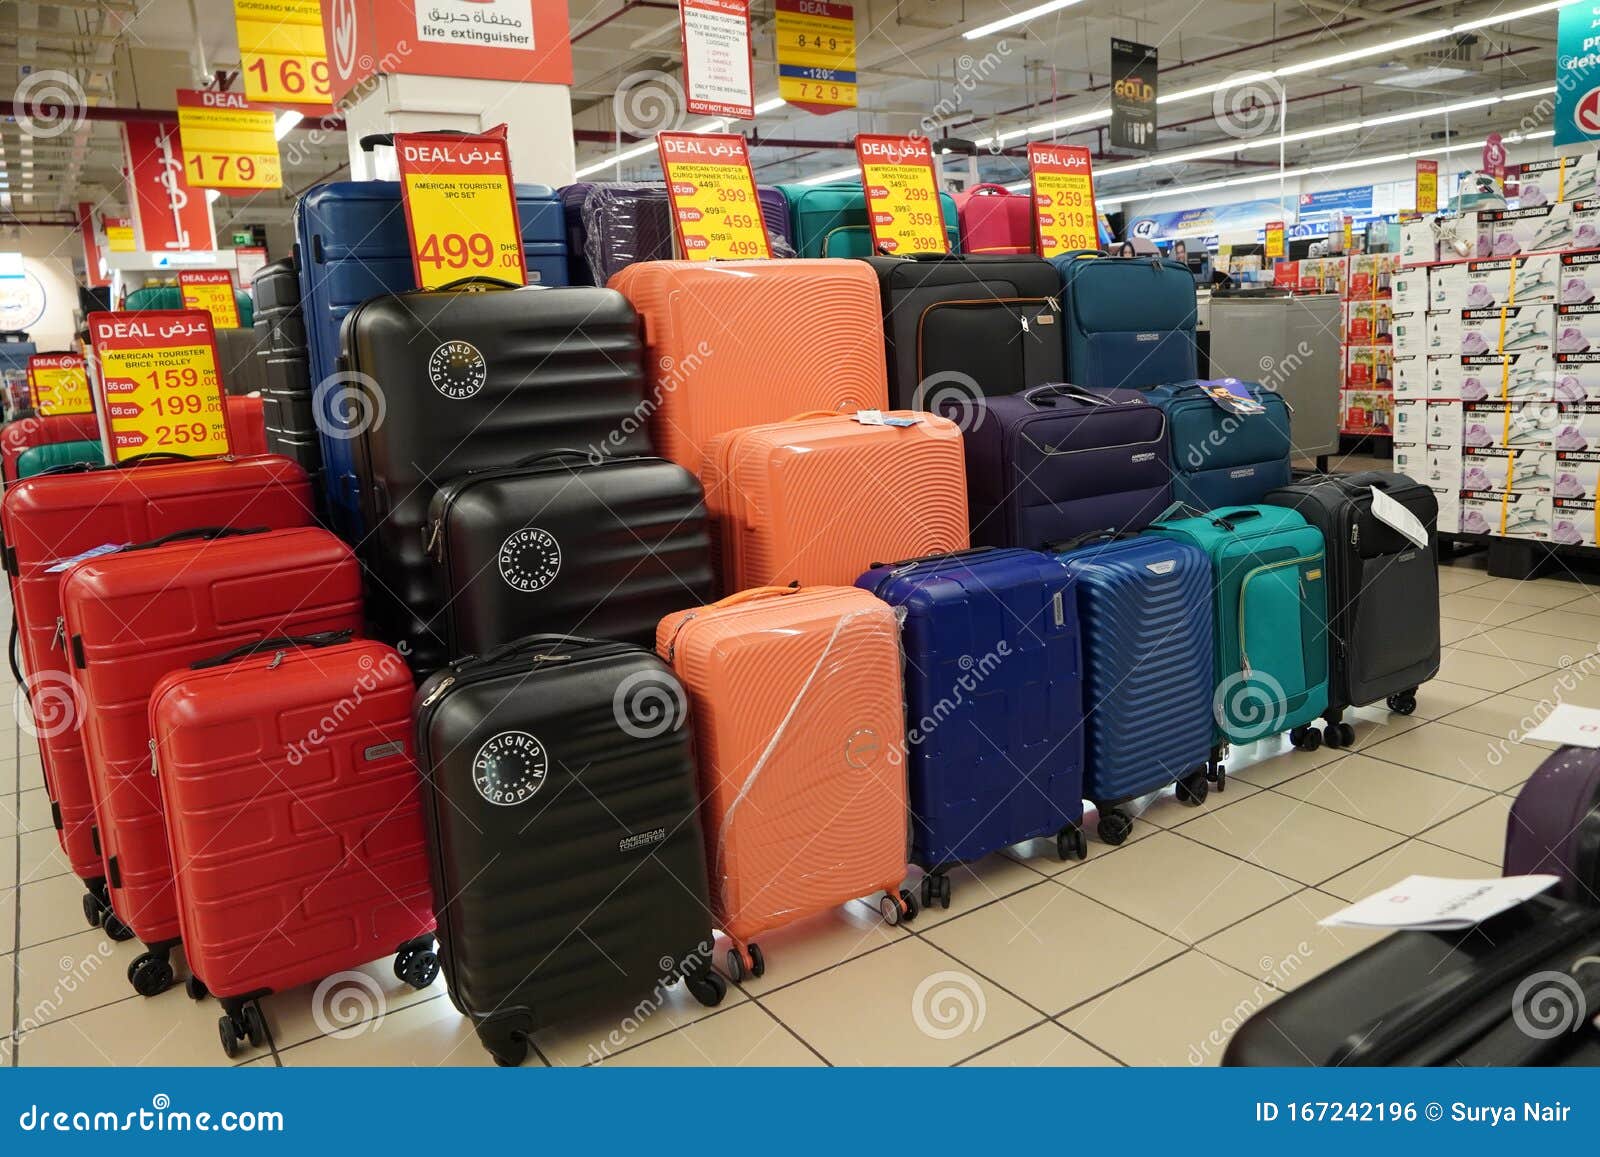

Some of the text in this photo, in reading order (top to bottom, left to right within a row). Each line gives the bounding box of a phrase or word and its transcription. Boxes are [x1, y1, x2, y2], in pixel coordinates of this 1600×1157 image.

[238, 2, 283, 12] GIORDANO
[800, 1, 830, 16] DEAL
[428, 8, 522, 28] مطفأة حريق
[720, 16, 746, 26] CUSTOMER
[422, 25, 529, 44] fire extinguisher
[704, 32, 732, 40] WARRANTY
[248, 57, 331, 95] 169
[800, 83, 838, 100] 729
[1114, 80, 1154, 104] GOLD
[203, 92, 248, 108] DEAL
[690, 102, 708, 110] BODY
[722, 106, 752, 116] INCLUDED
[404, 146, 456, 162] DEAL
[665, 140, 706, 154] DEAL
[708, 143, 744, 156] عرض
[862, 142, 897, 156] DEAL
[898, 144, 928, 158] عرض
[459, 148, 504, 164] عرض
[1033, 152, 1062, 165] DEAL
[1063, 154, 1087, 167] عرض
[189, 155, 255, 180] 179
[717, 188, 747, 202] 399
[904, 188, 928, 200] 299
[1056, 192, 1082, 207] 259
[723, 215, 752, 228] 459
[908, 213, 932, 226] 359
[1058, 212, 1084, 228] 319
[1316, 222, 1329, 233] PC
[729, 241, 758, 255] 499
[912, 237, 936, 250] 399
[1061, 234, 1087, 249] 369
[418, 232, 494, 270] 499
[498, 253, 522, 268] .00
[208, 274, 228, 282] عرض
[98, 322, 155, 339] DEAL
[160, 321, 208, 338] عرض
[108, 349, 205, 360] AMERICAN TOURISTER
[125, 358, 191, 368] BRICE TROLLEY
[432, 344, 483, 381] DESIGNED IN
[107, 382, 118, 390] 55
[146, 368, 198, 390] 159
[440, 372, 484, 396] EUROPE
[112, 406, 123, 415] 68
[151, 394, 202, 416] 199
[116, 436, 128, 444] 79
[156, 422, 208, 446] 259
[502, 531, 558, 564] DESIGNED IN
[504, 568, 554, 588] EUROPE
[476, 736, 544, 778] DESIGNED IN
[477, 776, 536, 802] EUROPE
[620, 828, 665, 845] AMERICAN
[620, 832, 665, 850] TOURISTER
